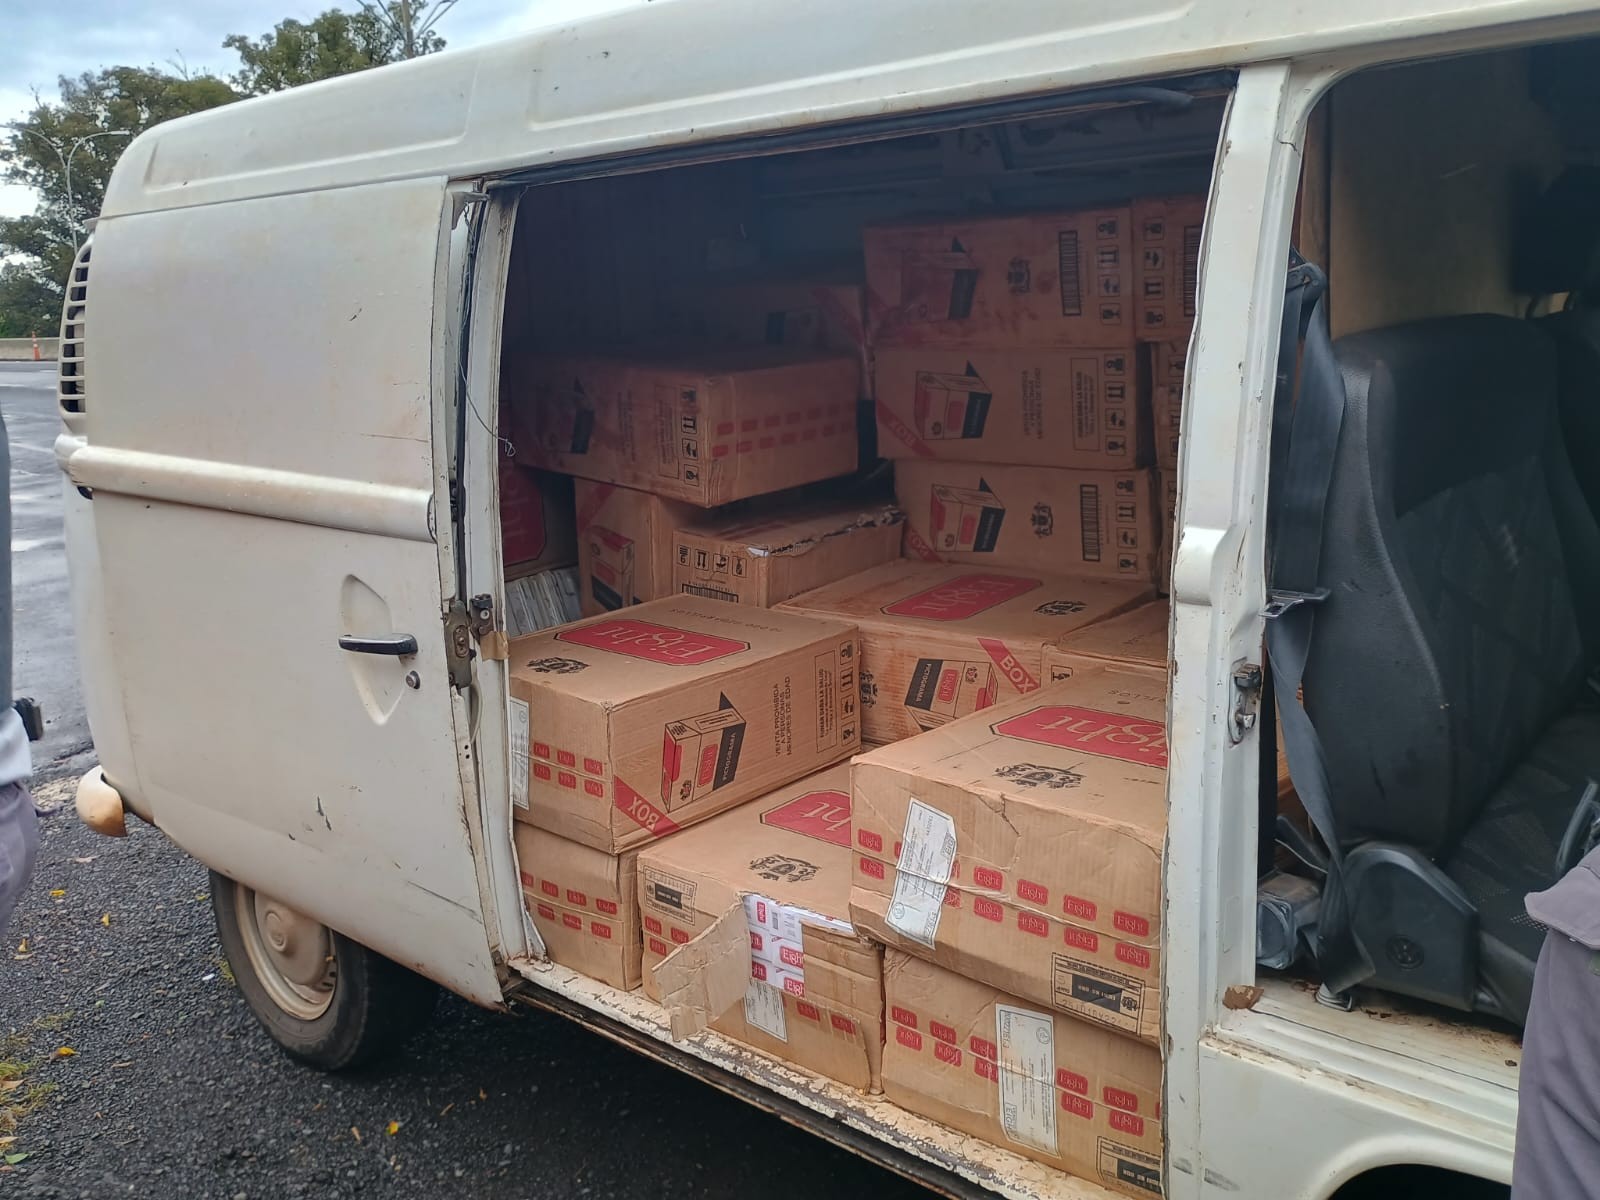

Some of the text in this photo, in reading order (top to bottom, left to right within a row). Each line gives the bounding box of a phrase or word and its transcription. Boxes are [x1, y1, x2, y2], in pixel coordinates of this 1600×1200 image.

[589, 626, 718, 661] Eight
[915, 663, 931, 703] PICTOGRAMA
[1000, 655, 1035, 693] BOX
[628, 796, 660, 832] BOX
[976, 871, 1000, 888] Eight
[1020, 884, 1044, 901] Eight
[1067, 900, 1092, 917] Eight
[1116, 915, 1144, 932] Eight
[783, 948, 804, 966] Eigh
[1060, 1072, 1084, 1090] Eight
[1108, 1090, 1134, 1106] Eight
